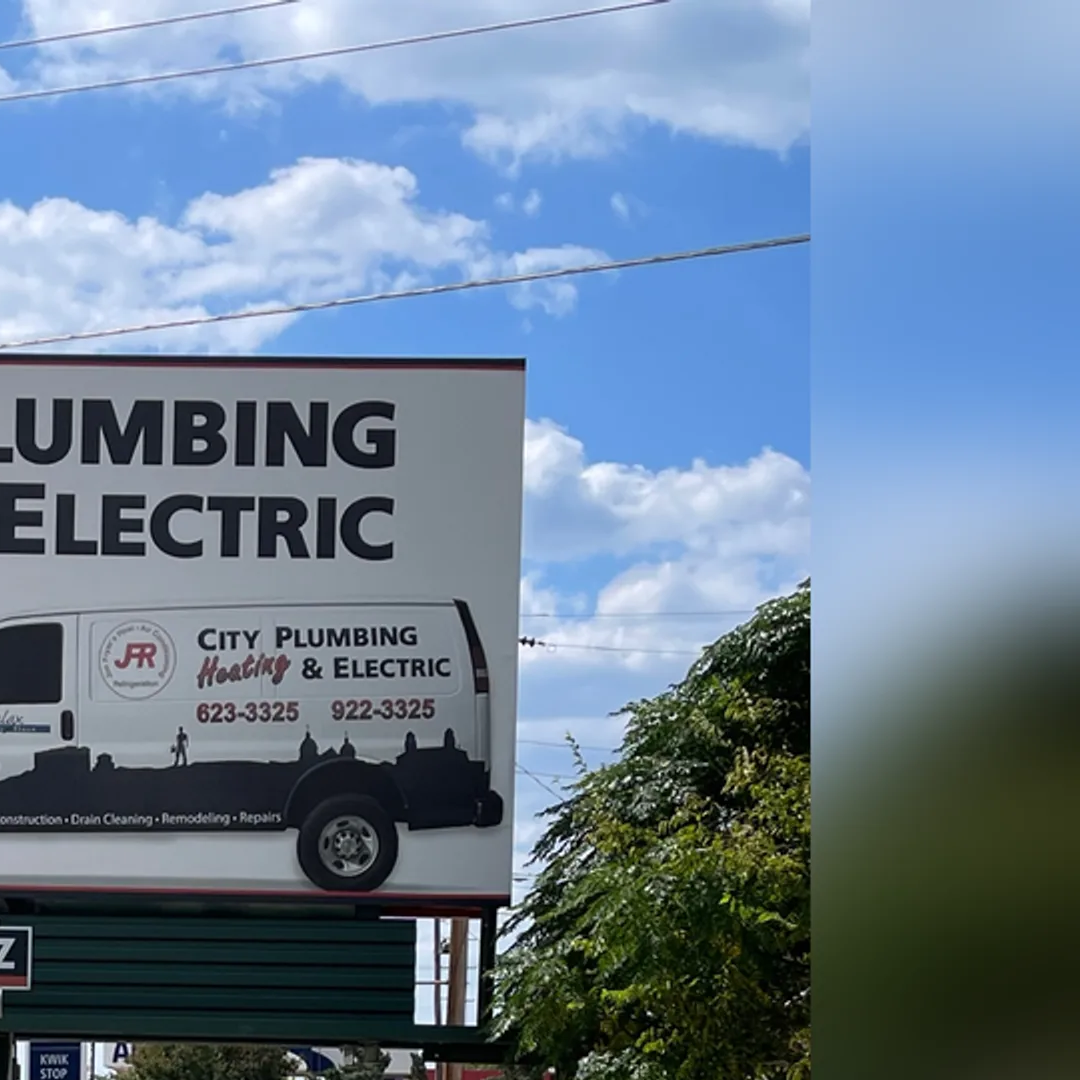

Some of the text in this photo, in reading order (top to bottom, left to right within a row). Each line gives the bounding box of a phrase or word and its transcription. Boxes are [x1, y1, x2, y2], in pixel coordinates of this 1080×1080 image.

[197, 626, 418, 651] CITY PLUMBING
[197, 653, 291, 690] Heating
[301, 657, 451, 679] & ELECTRIC
[196, 698, 435, 723] 623-3325 922-3325
[71, 813, 101, 825] Drain
[102, 813, 153, 827] Cleaning
[162, 812, 230, 826] Remodeling
[240, 811, 281, 825] Repairs
[40, 1068, 68, 1080] STOP
